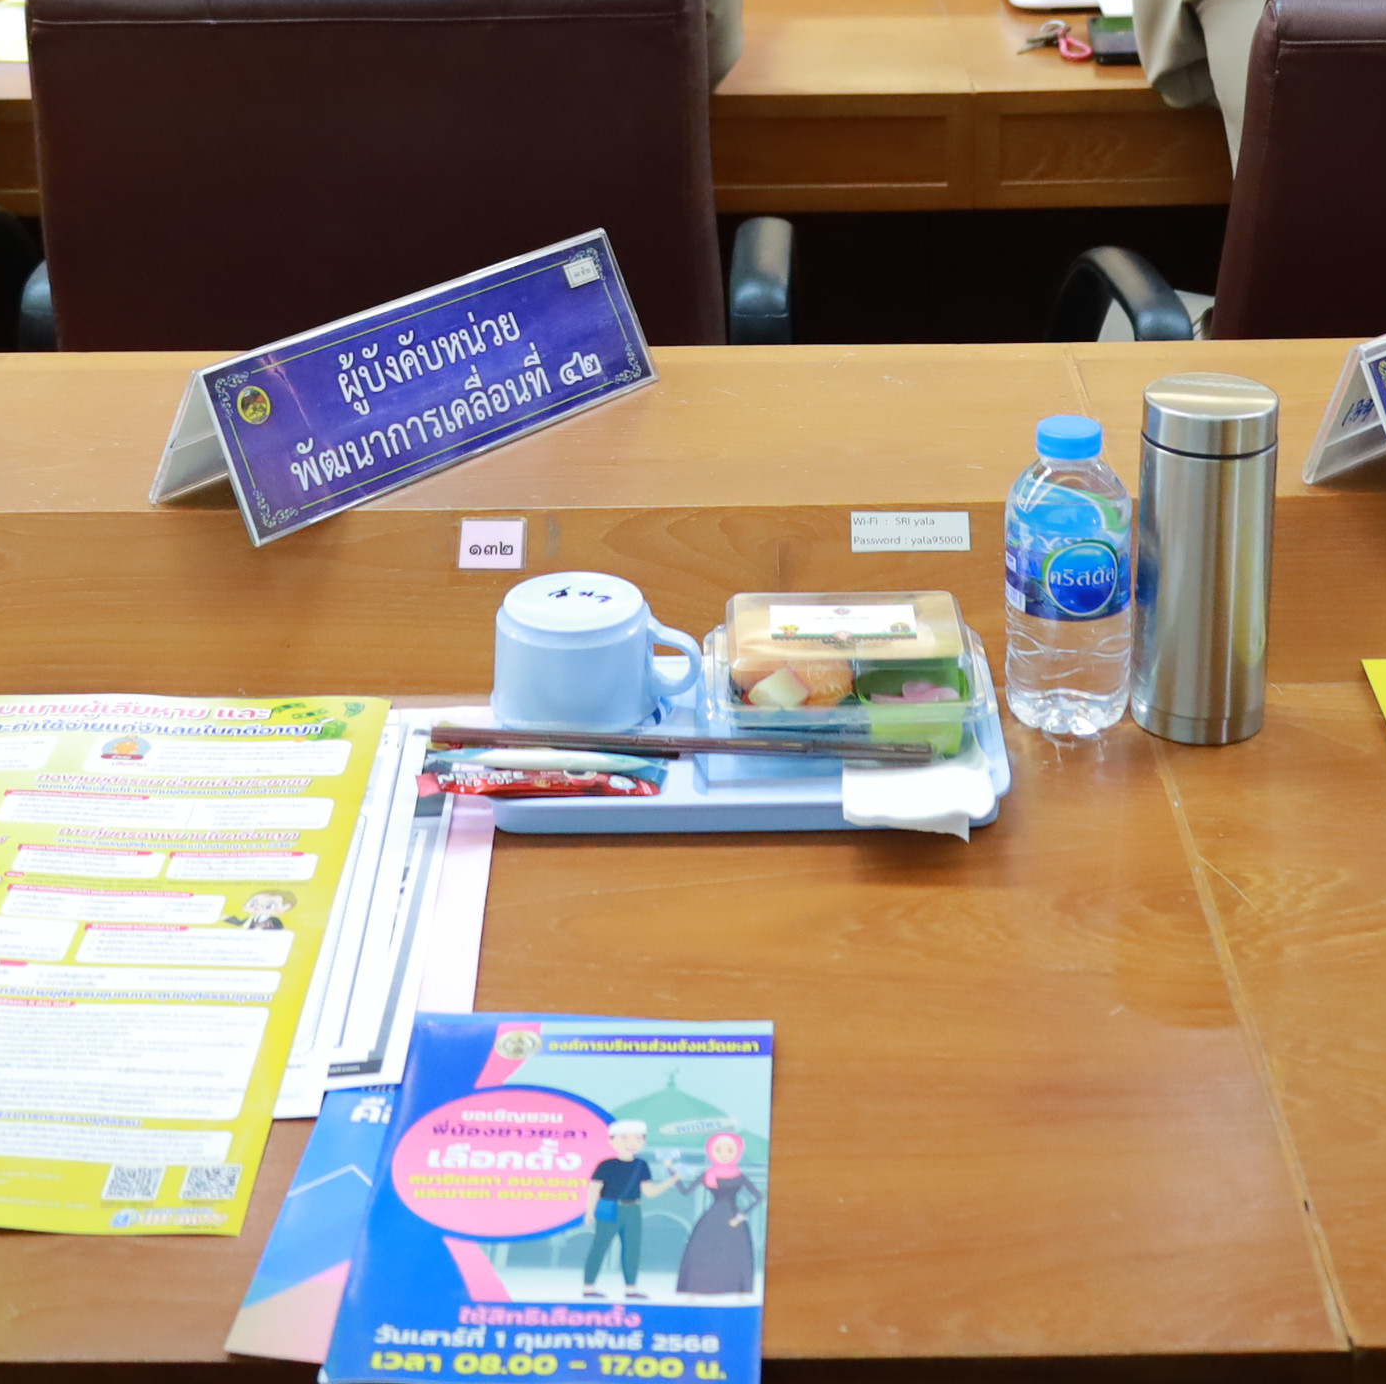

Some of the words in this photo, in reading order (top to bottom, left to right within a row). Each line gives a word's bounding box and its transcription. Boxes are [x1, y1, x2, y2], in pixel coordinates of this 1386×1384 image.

[337, 308, 521, 417] ผู้บังคับหน่วย
[291, 342, 552, 494] พัฒนาการเคลื่อนที่
[558, 351, 602, 386] ๔๒
[853, 517, 878, 526] Wi-Fi
[895, 517, 910, 526] SRI
[914, 517, 935, 528] yala
[468, 538, 515, 559] ๑๓๒
[854, 536, 900, 545] Password
[911, 536, 963, 547] yala95000
[217, 704, 273, 720] และ
[549, 1034, 760, 1054] องค์การบริหารส่วนจังหวัดยะลา
[461, 1108, 564, 1124] ขอเชิญชวน
[432, 1122, 588, 1140] พี่น้องชาวยะลา
[427, 1138, 582, 1172] เลือกตั้ง
[374, 1323, 488, 1349] วันเสาร์ที่
[495, 1330, 507, 1349] 1
[514, 1327, 645, 1355] กุมภาพันธ์
[650, 1334, 720, 1354] 2568
[370, 1351, 442, 1373] เวลา
[453, 1353, 559, 1376] 08.00
[599, 1356, 685, 1378] 17.00
[695, 1360, 727, 1380] น.
